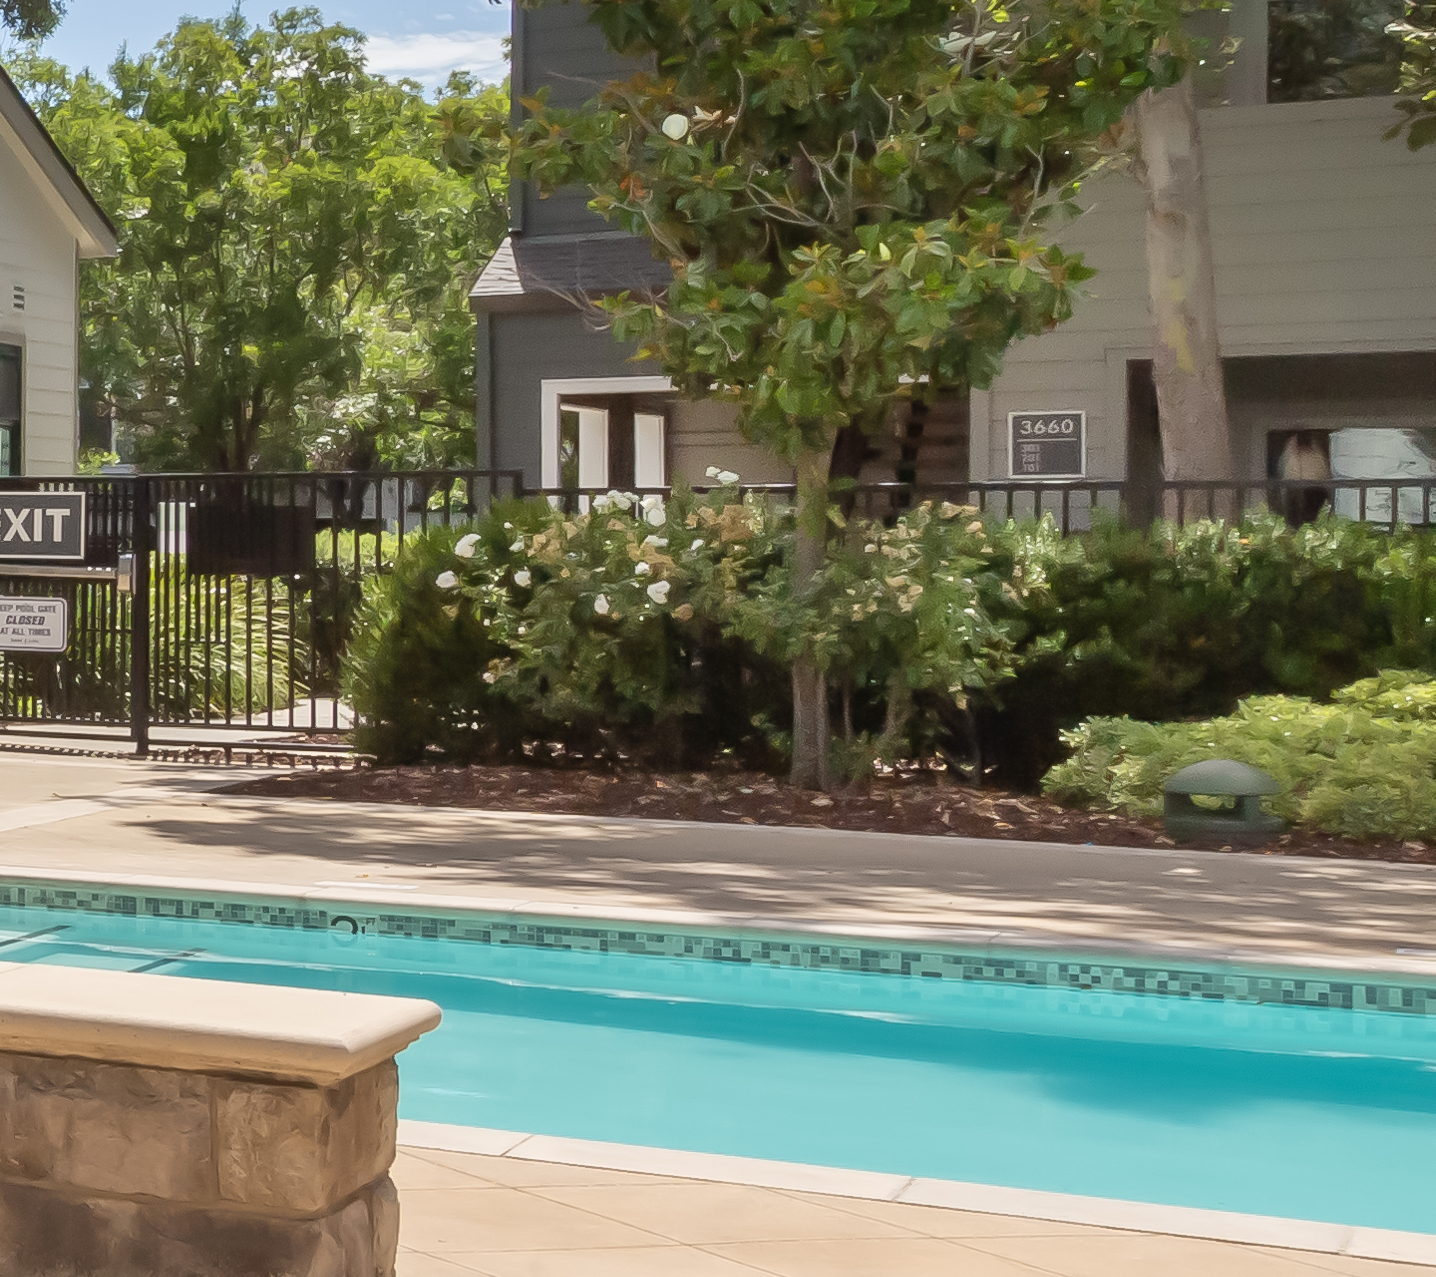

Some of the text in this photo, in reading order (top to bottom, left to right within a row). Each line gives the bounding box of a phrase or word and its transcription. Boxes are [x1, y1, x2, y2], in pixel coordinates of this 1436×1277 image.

[1020, 419, 1074, 435] 3660
[16, 604, 36, 613] POOL
[38, 605, 57, 614] GATE
[6, 614, 46, 626] CLOSED
[0, 627, 52, 637] AT ALL TIMES
